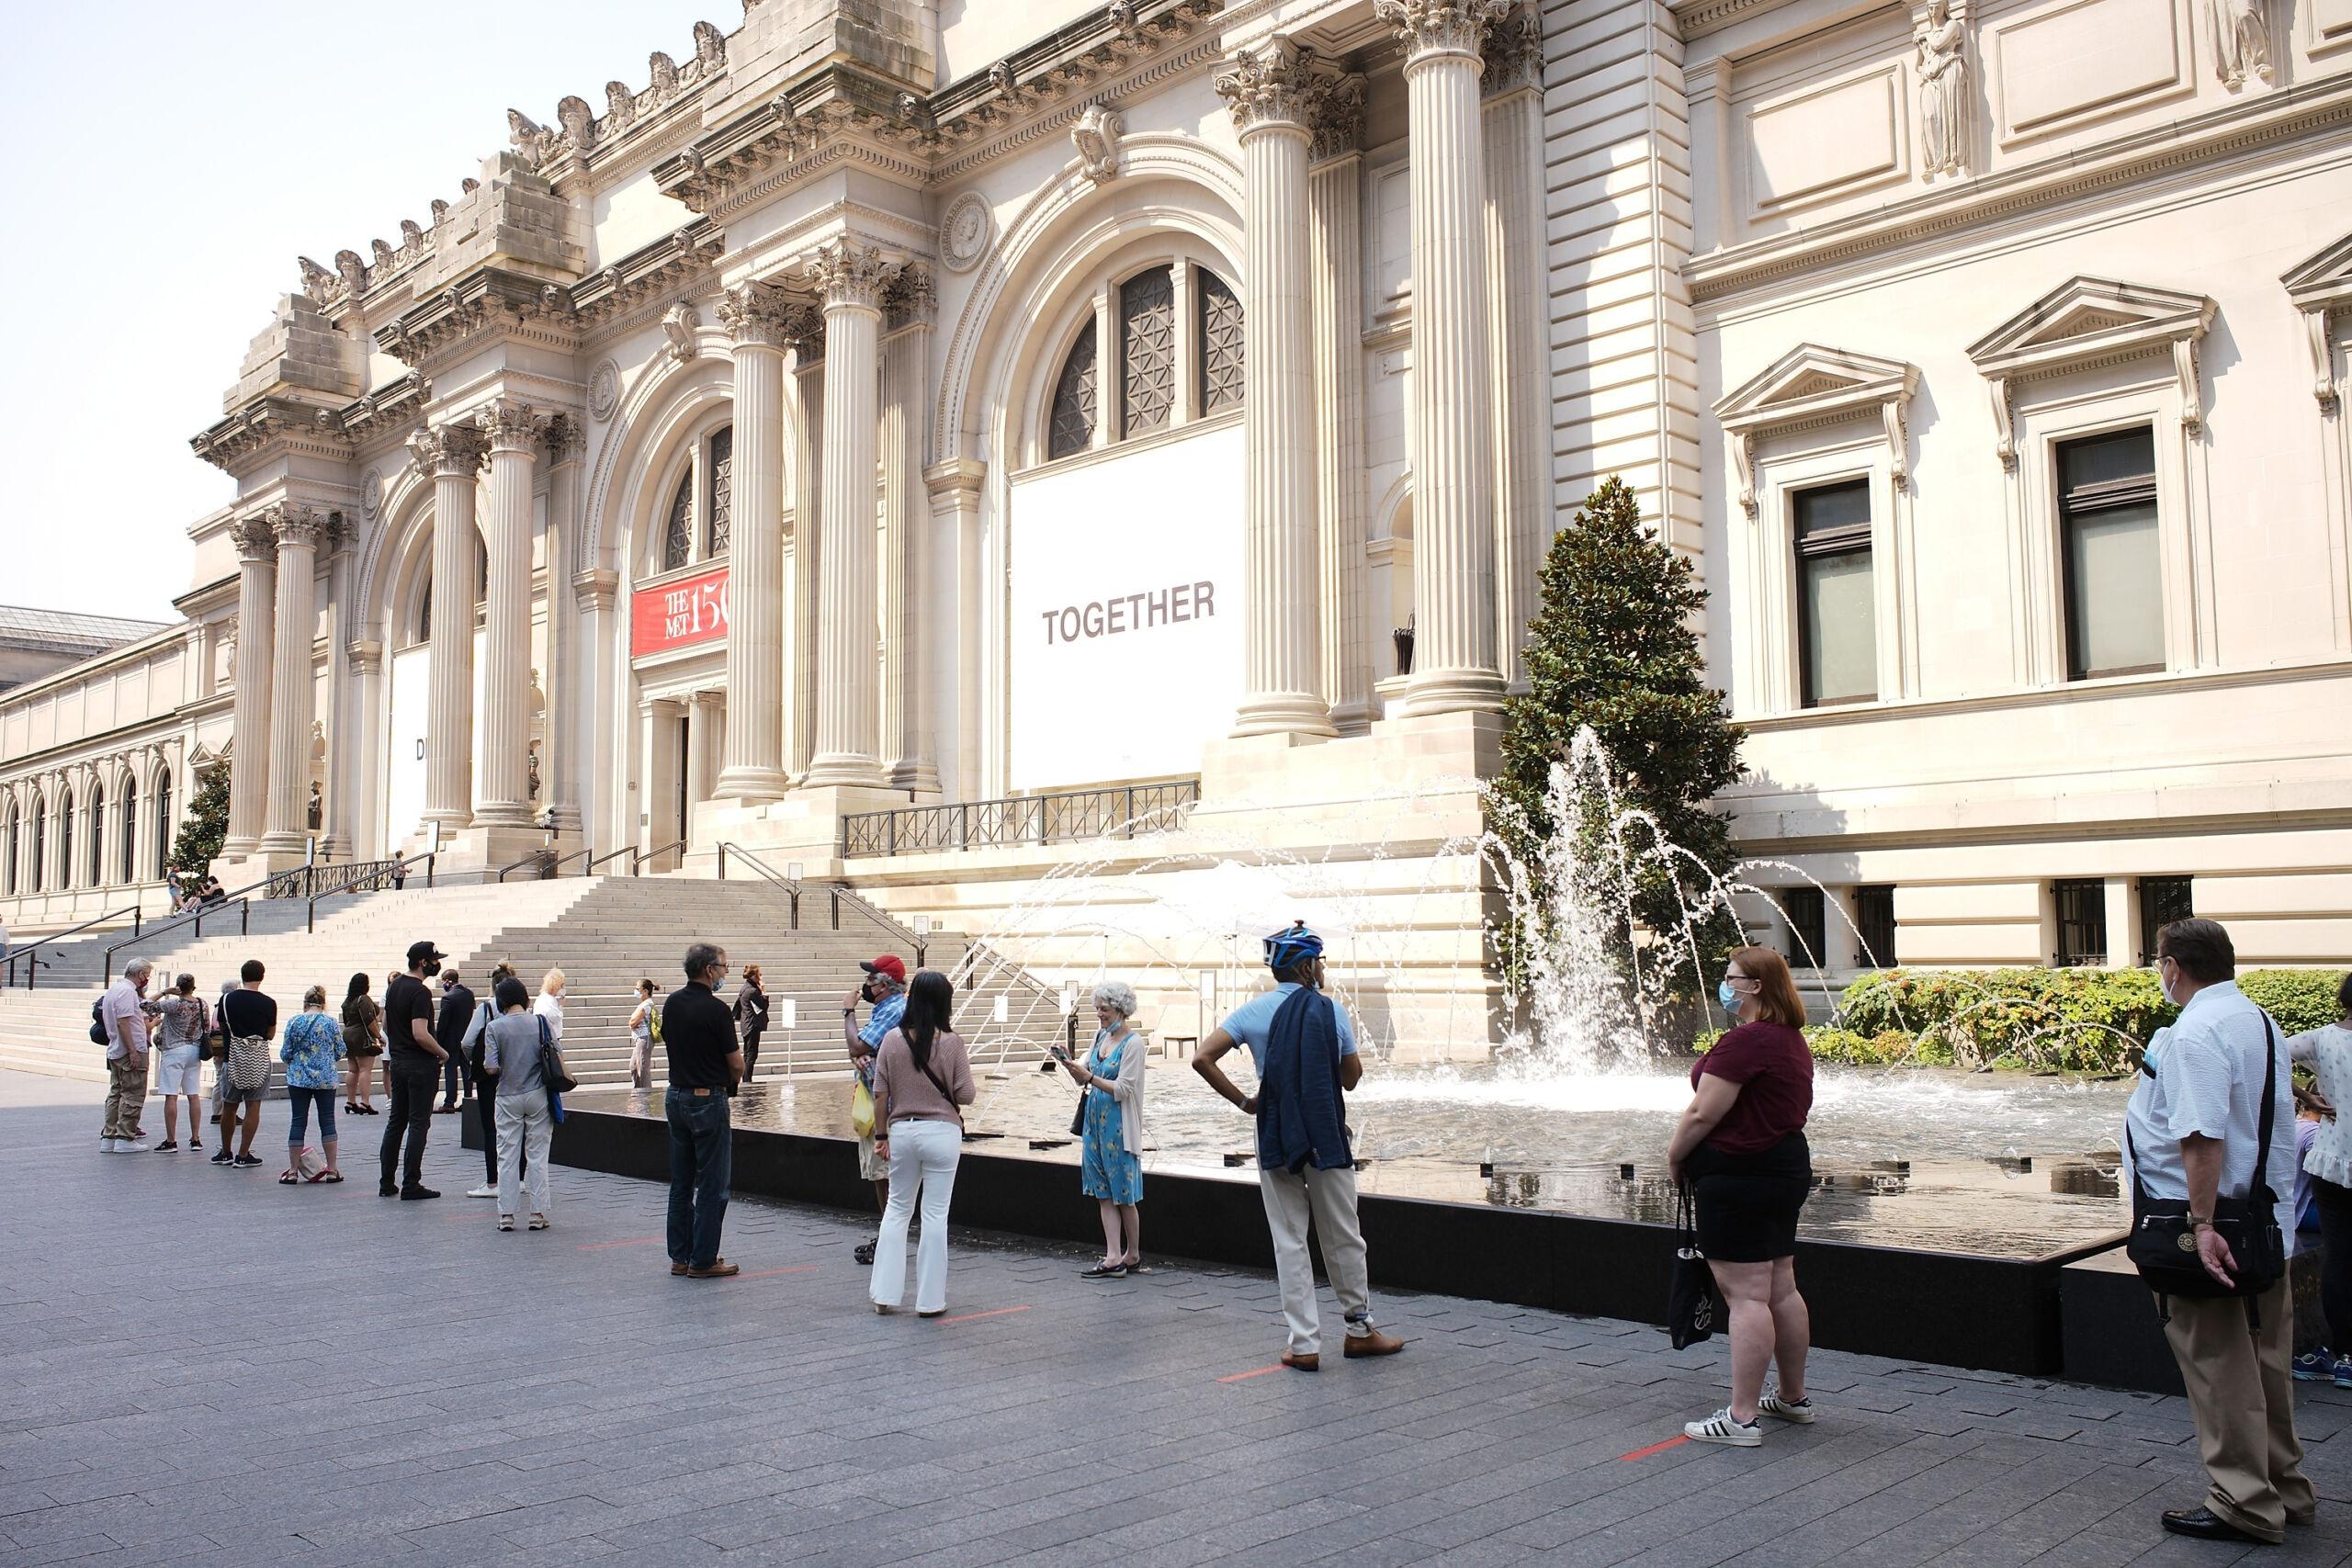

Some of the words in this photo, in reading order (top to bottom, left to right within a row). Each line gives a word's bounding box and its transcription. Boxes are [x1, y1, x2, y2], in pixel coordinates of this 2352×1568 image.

[664, 589, 689, 616] THE
[1043, 581, 1215, 645] TOGETHER
[664, 613, 690, 640] MET
